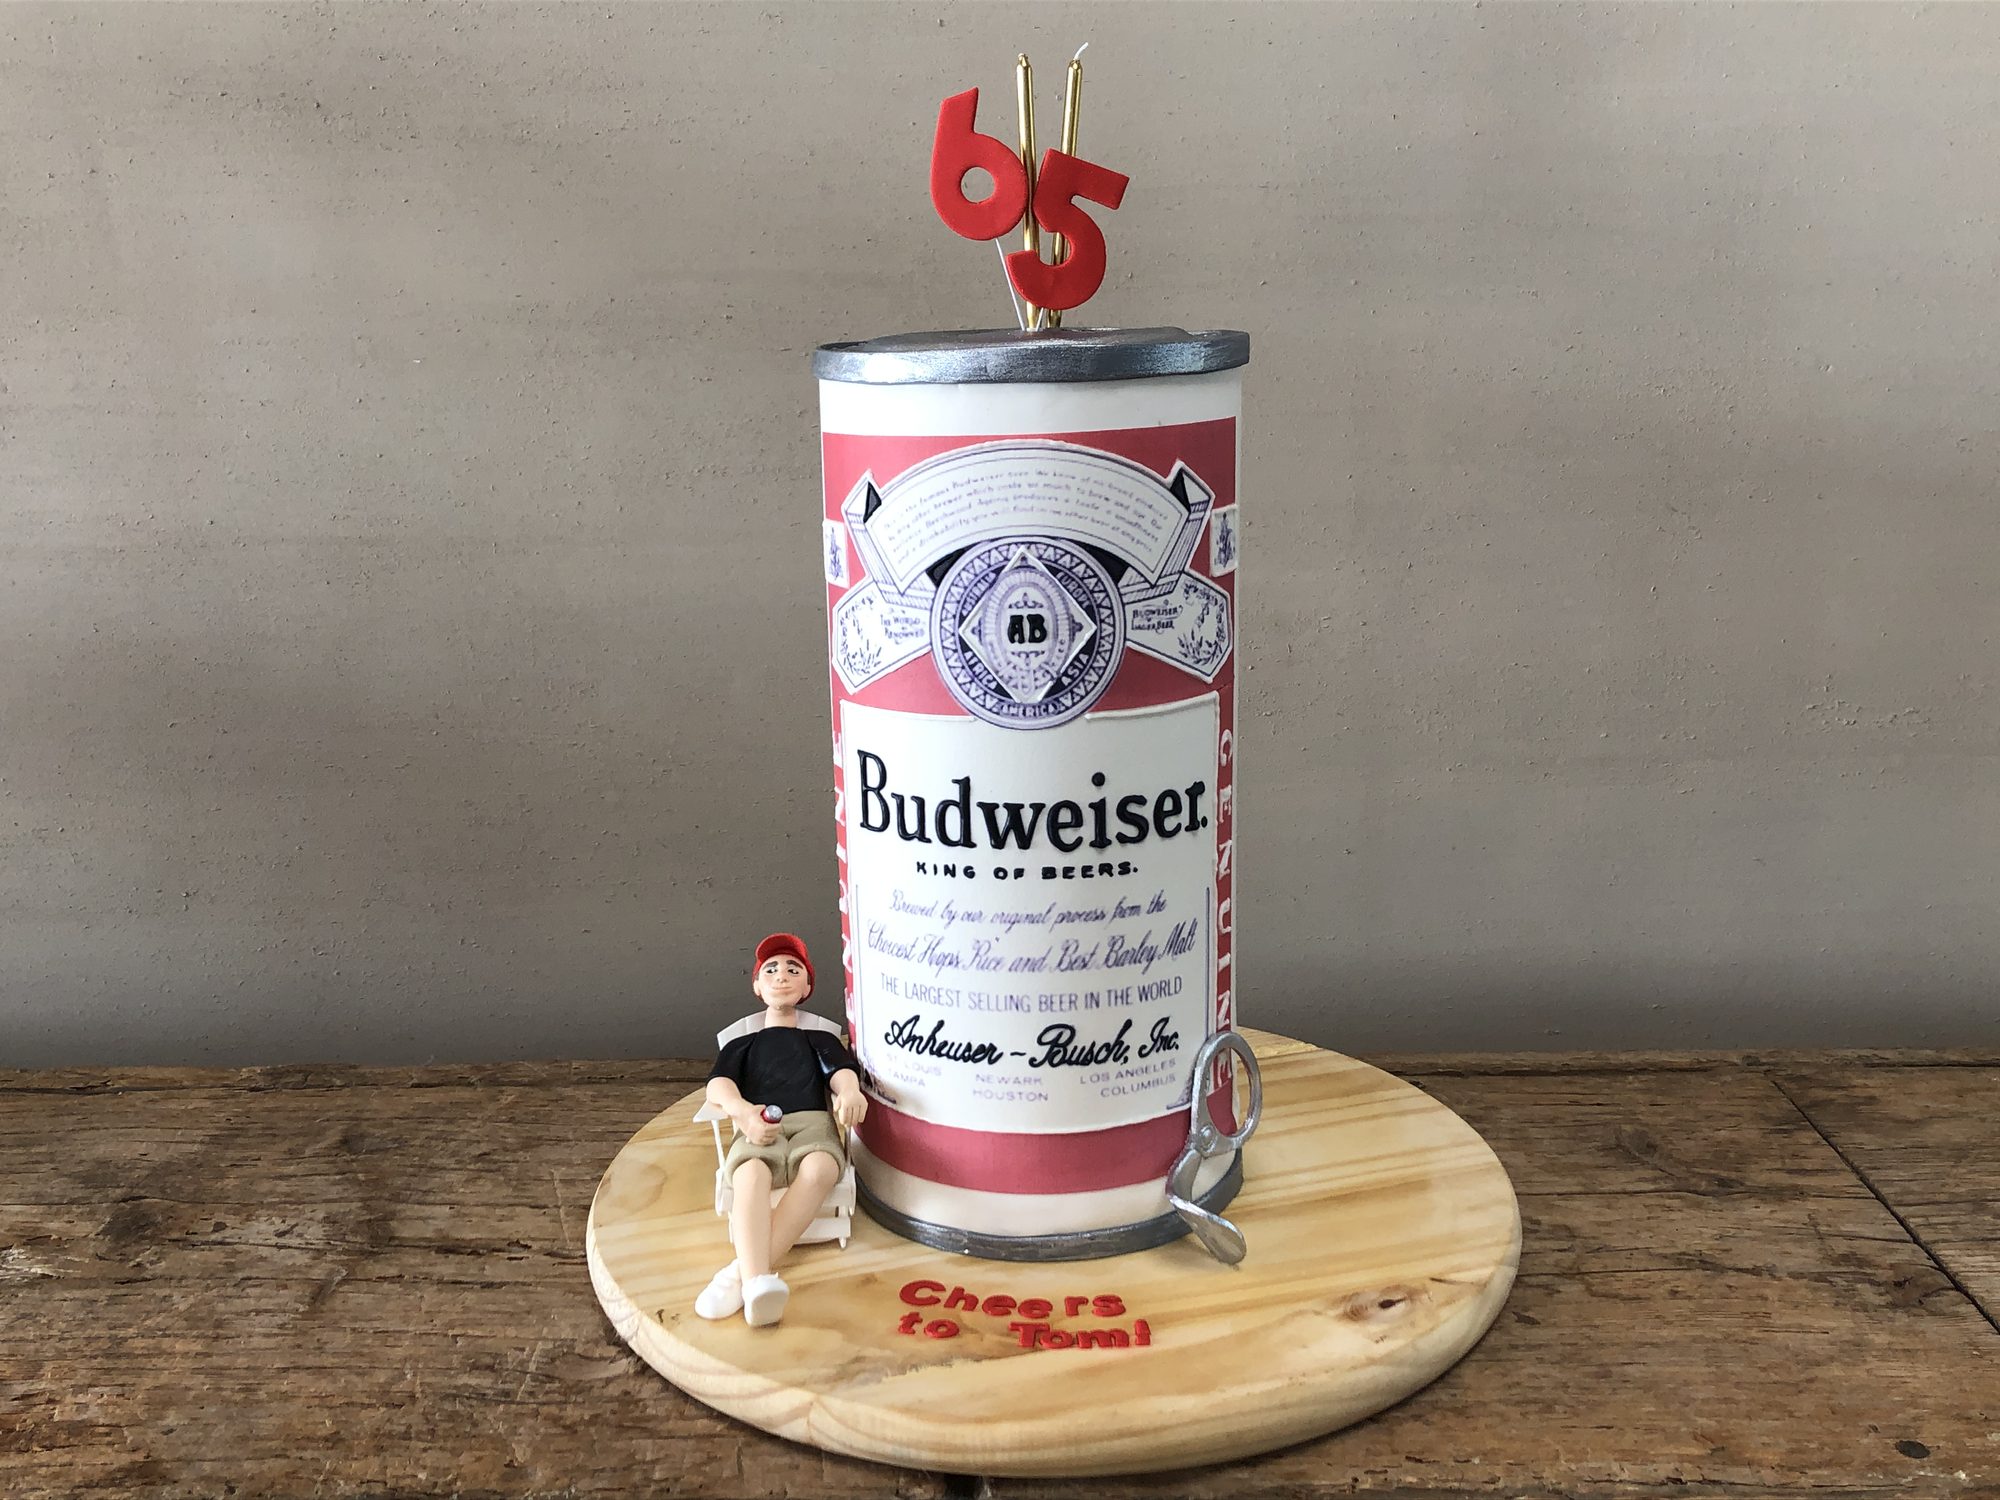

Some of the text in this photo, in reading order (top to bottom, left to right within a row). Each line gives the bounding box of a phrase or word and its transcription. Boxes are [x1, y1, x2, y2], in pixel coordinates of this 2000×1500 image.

[930, 87, 1130, 310] 65
[1007, 613, 1048, 645] AB
[1061, 651, 1090, 686] ASIA
[916, 861, 976, 879] KING
[993, 866, 1025, 880] OF
[940, 899, 959, 930] by
[990, 901, 1057, 934] original
[1048, 907, 1107, 935] process
[1103, 895, 1142, 931] from
[1146, 889, 1168, 916] the
[1008, 946, 1052, 974] and
[1050, 938, 1101, 974] Best
[1097, 929, 1160, 976] Barley
[1157, 917, 1198, 961] Malt
[881, 972, 1182, 1014] THE LARGEST SELLING BEER IN THE WORLD
[884, 1014, 1004, 1065] Anheuser
[1138, 1016, 1180, 1058] Inc.
[973, 1088, 1049, 1102] HOUSTON
[1080, 1071, 1110, 1085] LOS
[1100, 1072, 1177, 1098] COLUMBUS
[899, 1279, 1126, 1319] Cheers
[898, 1311, 960, 1338] to
